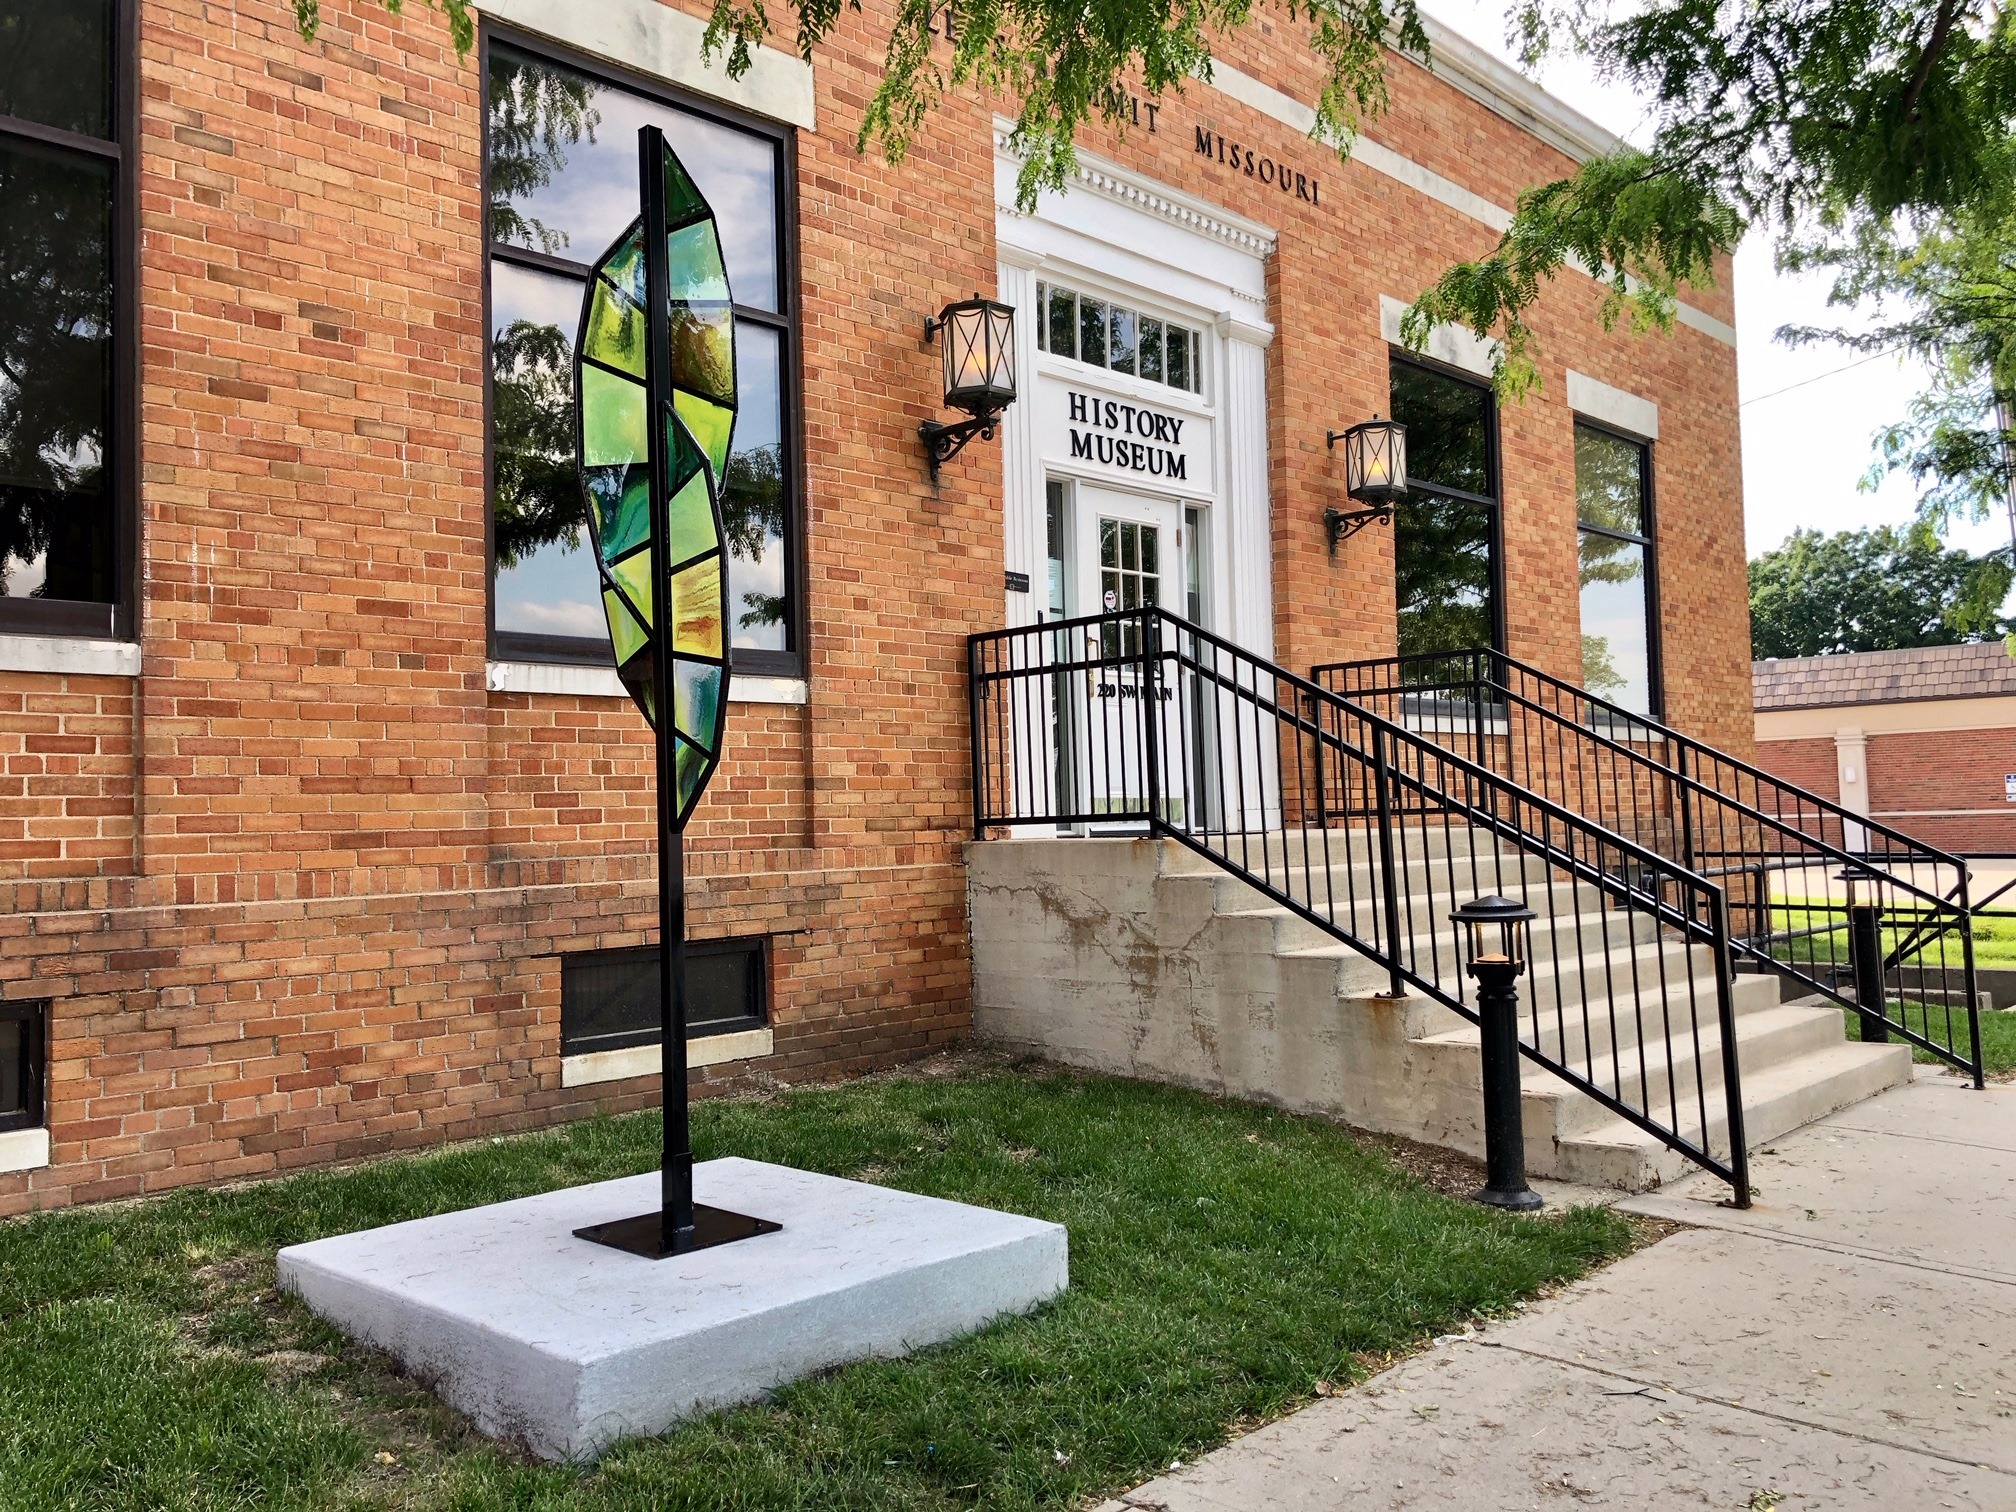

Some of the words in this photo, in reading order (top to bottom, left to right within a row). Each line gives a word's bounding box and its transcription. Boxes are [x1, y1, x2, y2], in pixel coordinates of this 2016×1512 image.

[1195, 125, 1318, 206] MISSOURI
[1068, 391, 1184, 445] HISTORY
[1070, 429, 1187, 480] MUSEUM
[1140, 686, 1172, 701] AN
